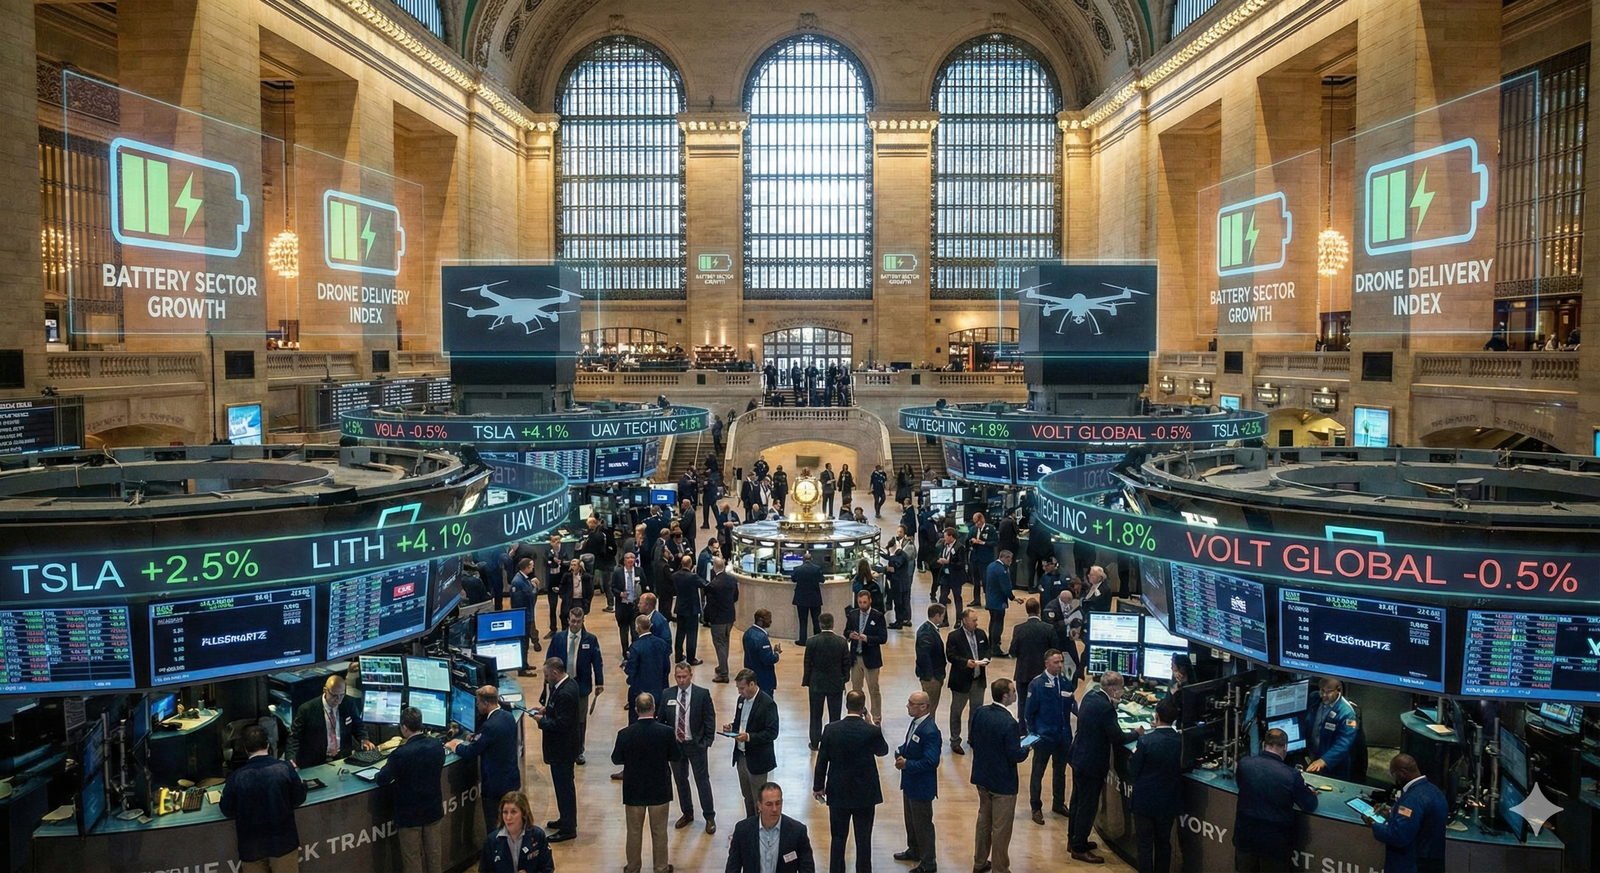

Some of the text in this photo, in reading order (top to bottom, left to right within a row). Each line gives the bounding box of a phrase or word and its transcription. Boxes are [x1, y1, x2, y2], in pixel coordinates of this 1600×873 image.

[102, 263, 258, 296] BATTERY SECTOR
[1355, 258, 1494, 293] DRONE DELIVERY
[317, 282, 410, 305] DRONE DELIVERY
[1210, 281, 1296, 305] BATTERY SECTOR
[1393, 292, 1442, 316] INDEX
[147, 295, 226, 320] GROWTH
[349, 306, 383, 324] INDEX
[1228, 305, 1272, 323] GROWTH
[409, 425, 448, 439] -0.5%
[473, 425, 515, 439] TSLA
[521, 424, 569, 438] +4.1%
[591, 423, 620, 437] UAV
[624, 421, 656, 435] TECH
[660, 419, 678, 433] INC
[679, 417, 701, 430] +1.8%
[921, 418, 945, 432] TECH
[948, 421, 966, 435] INC
[970, 423, 1010, 438] +1.8%
[1031, 424, 1073, 439] VOLT
[1078, 425, 1147, 440] GLOBAL
[1151, 426, 1192, 440] -0.5%
[1211, 422, 1240, 438] TSLA
[11, 560, 125, 594] TSLA
[141, 549, 259, 584] +2.5%
[312, 534, 385, 569] LITH
[396, 521, 472, 553] +4.1%
[503, 506, 536, 536] UAV
[538, 495, 564, 526] TECH
[1062, 505, 1087, 535] INC
[1092, 517, 1157, 551] +1.8%
[1186, 531, 1271, 568] VOLT
[1282, 544, 1447, 585] GLOBAL
[1463, 558, 1579, 593] -0.5%
